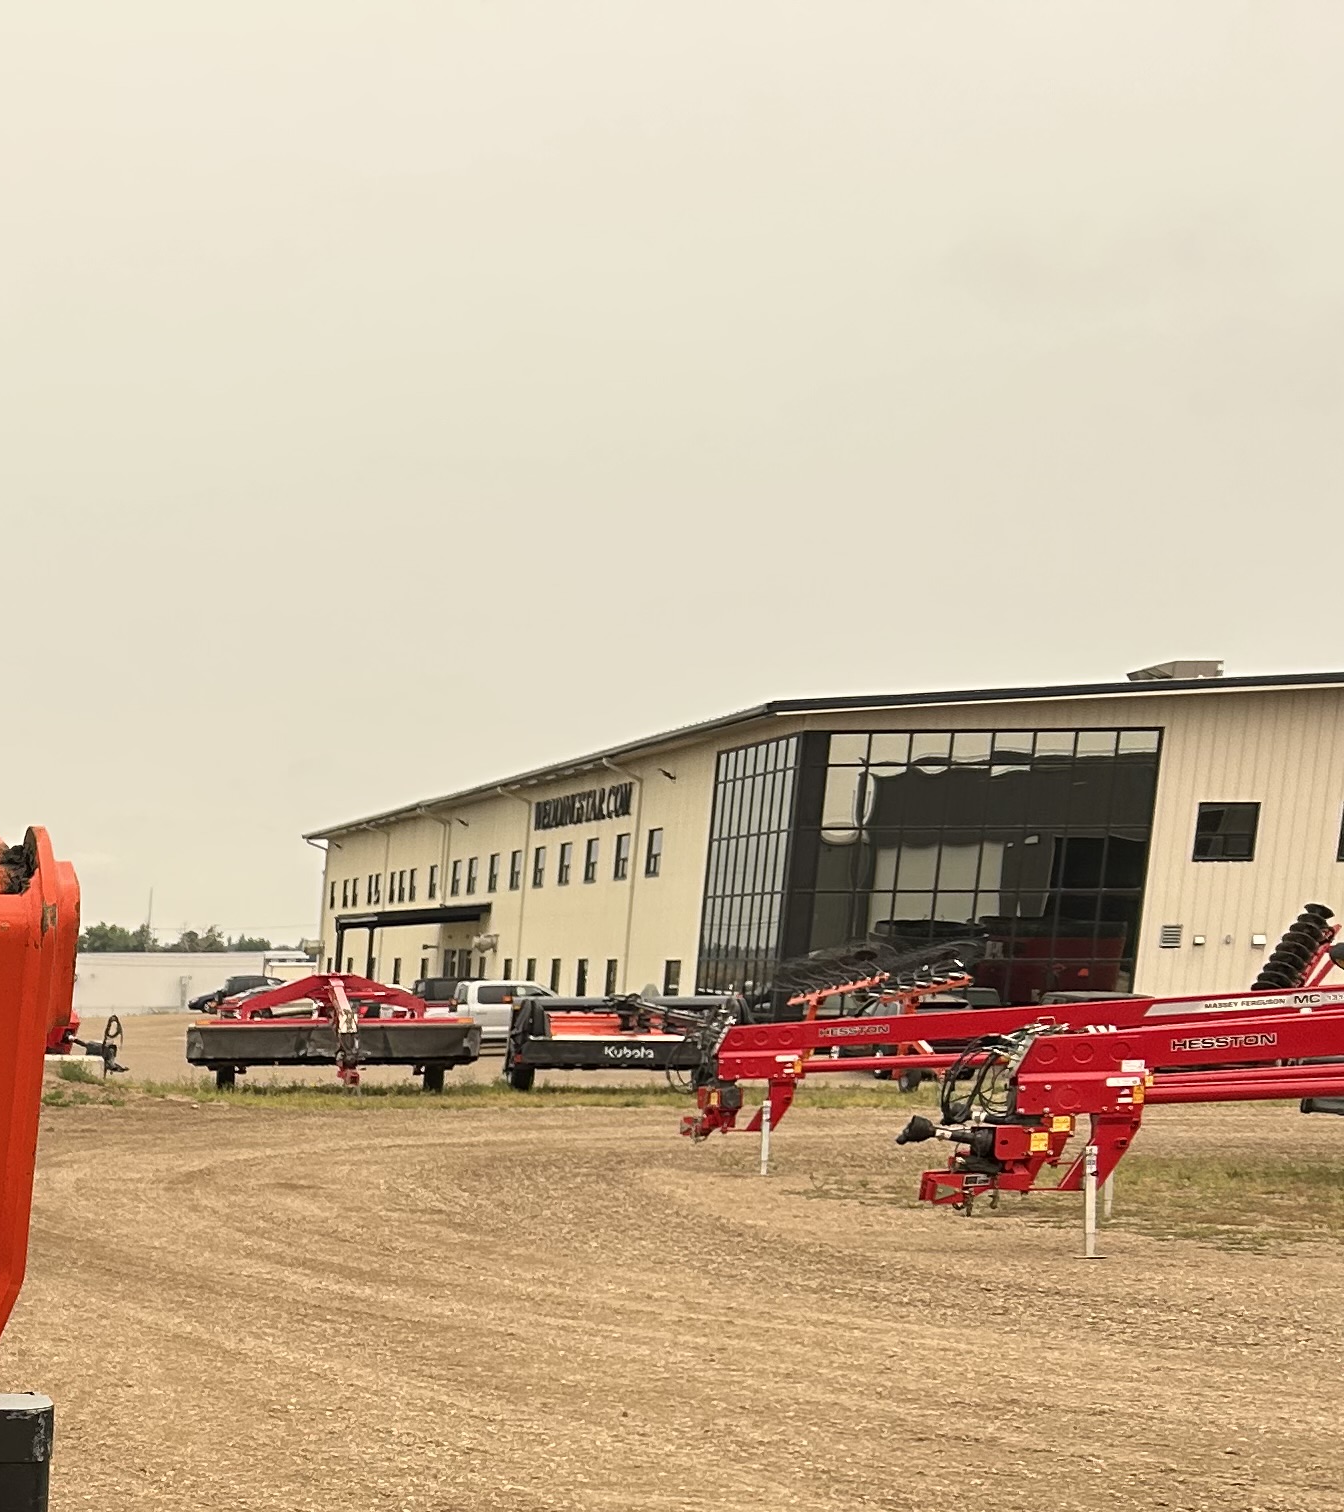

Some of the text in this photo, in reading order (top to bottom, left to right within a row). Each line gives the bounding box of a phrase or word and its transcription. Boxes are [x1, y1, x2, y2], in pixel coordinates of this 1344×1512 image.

[1204, 1001, 1238, 1009] MASSEY
[1241, 998, 1286, 1007] FERGUSON
[1293, 994, 1321, 1004] MC
[818, 1024, 890, 1038] HESSTON
[1171, 1033, 1277, 1051] HESSTON
[604, 1046, 654, 1058] Kubota
